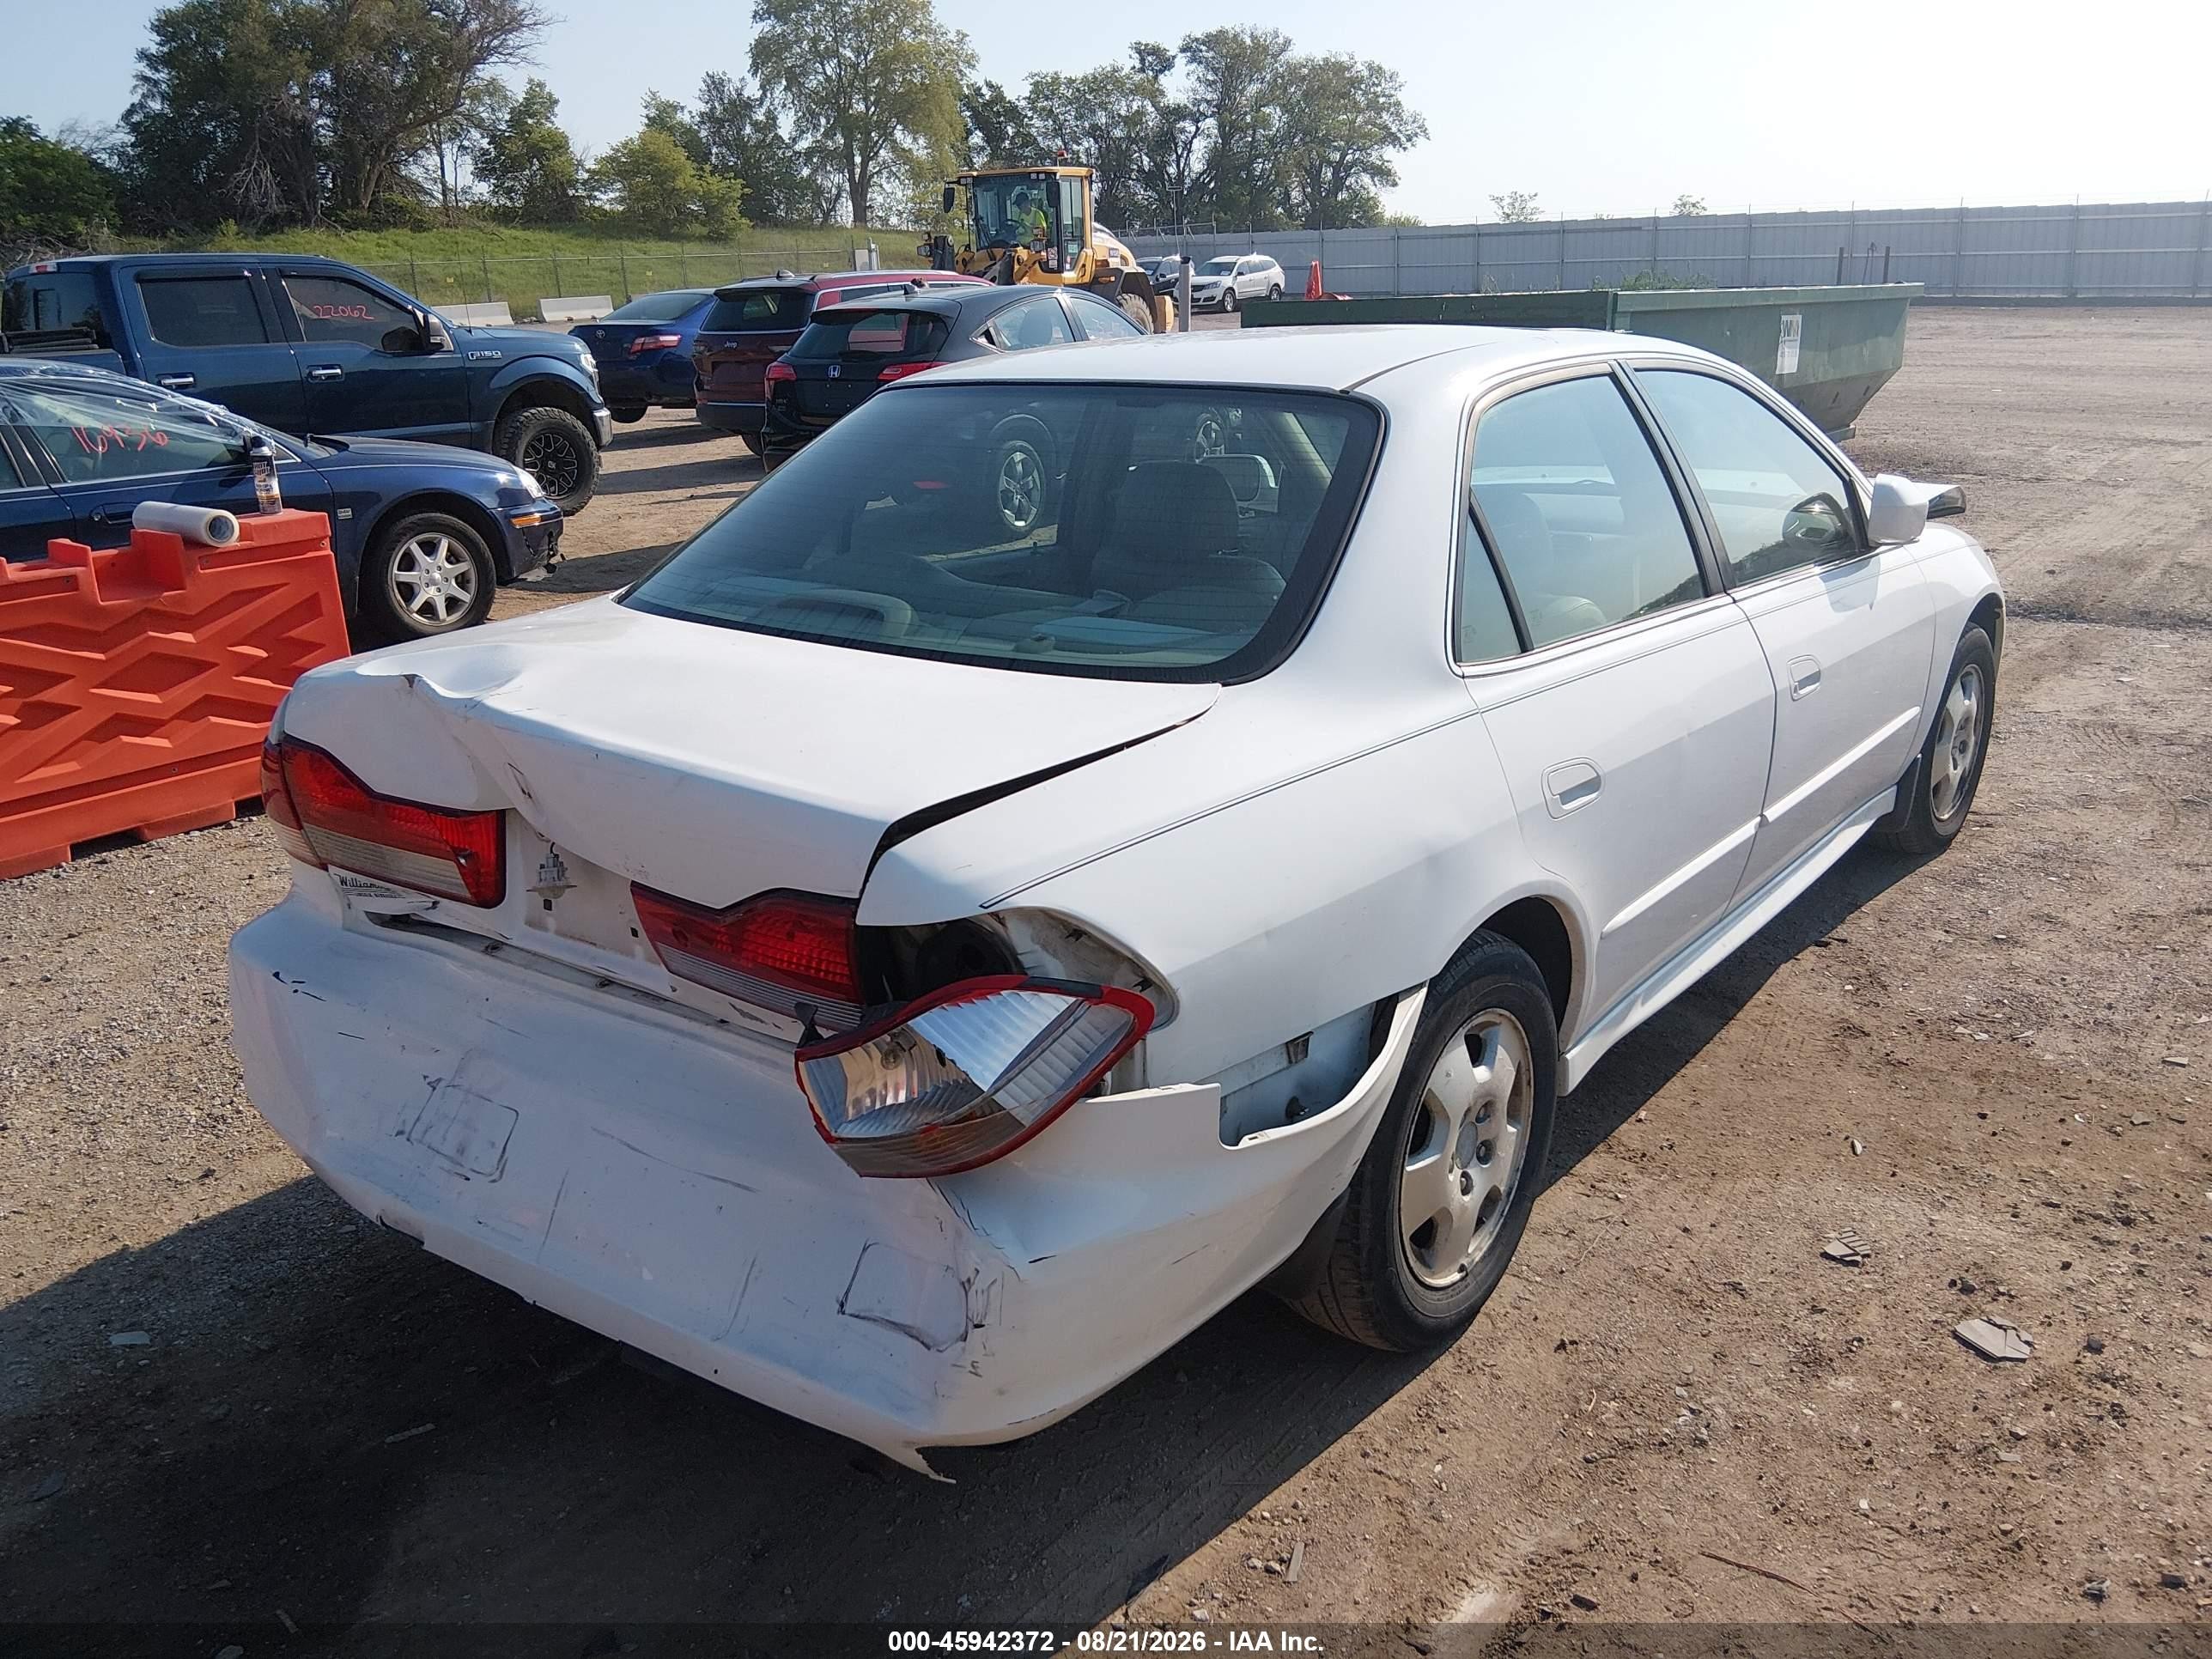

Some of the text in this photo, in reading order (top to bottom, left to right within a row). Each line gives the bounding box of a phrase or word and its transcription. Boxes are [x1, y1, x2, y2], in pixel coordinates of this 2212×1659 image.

[313, 304, 375, 320] 22062
[724, 340, 738, 349] Jeep
[333, 872, 392, 891] William
